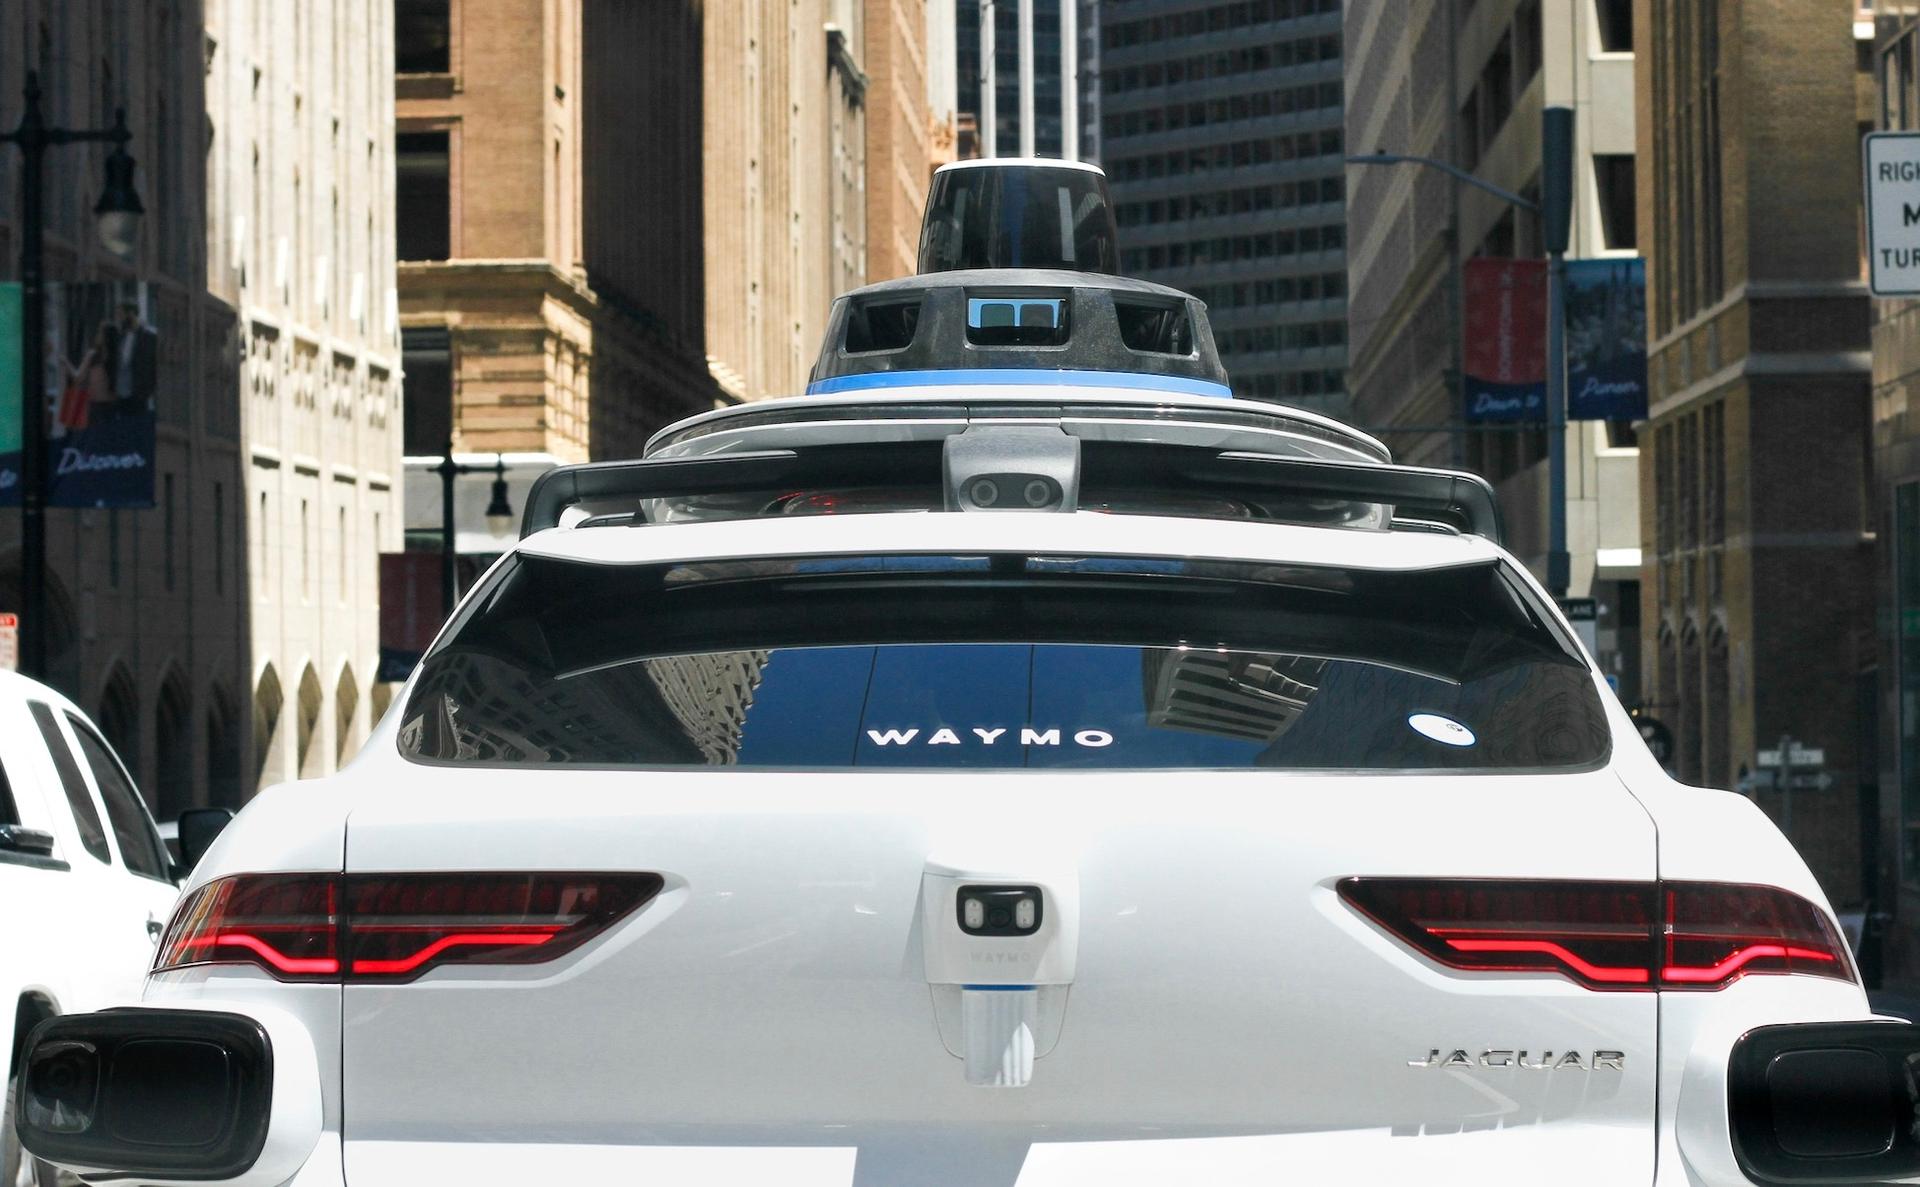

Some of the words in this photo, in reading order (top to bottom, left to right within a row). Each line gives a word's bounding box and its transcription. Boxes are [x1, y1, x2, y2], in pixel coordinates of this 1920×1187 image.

[57, 447, 147, 475] Discover
[867, 728, 1114, 747] WAYMO
[970, 951, 1033, 963] WAYMO
[1407, 1048, 1625, 1071] JAGUAR
